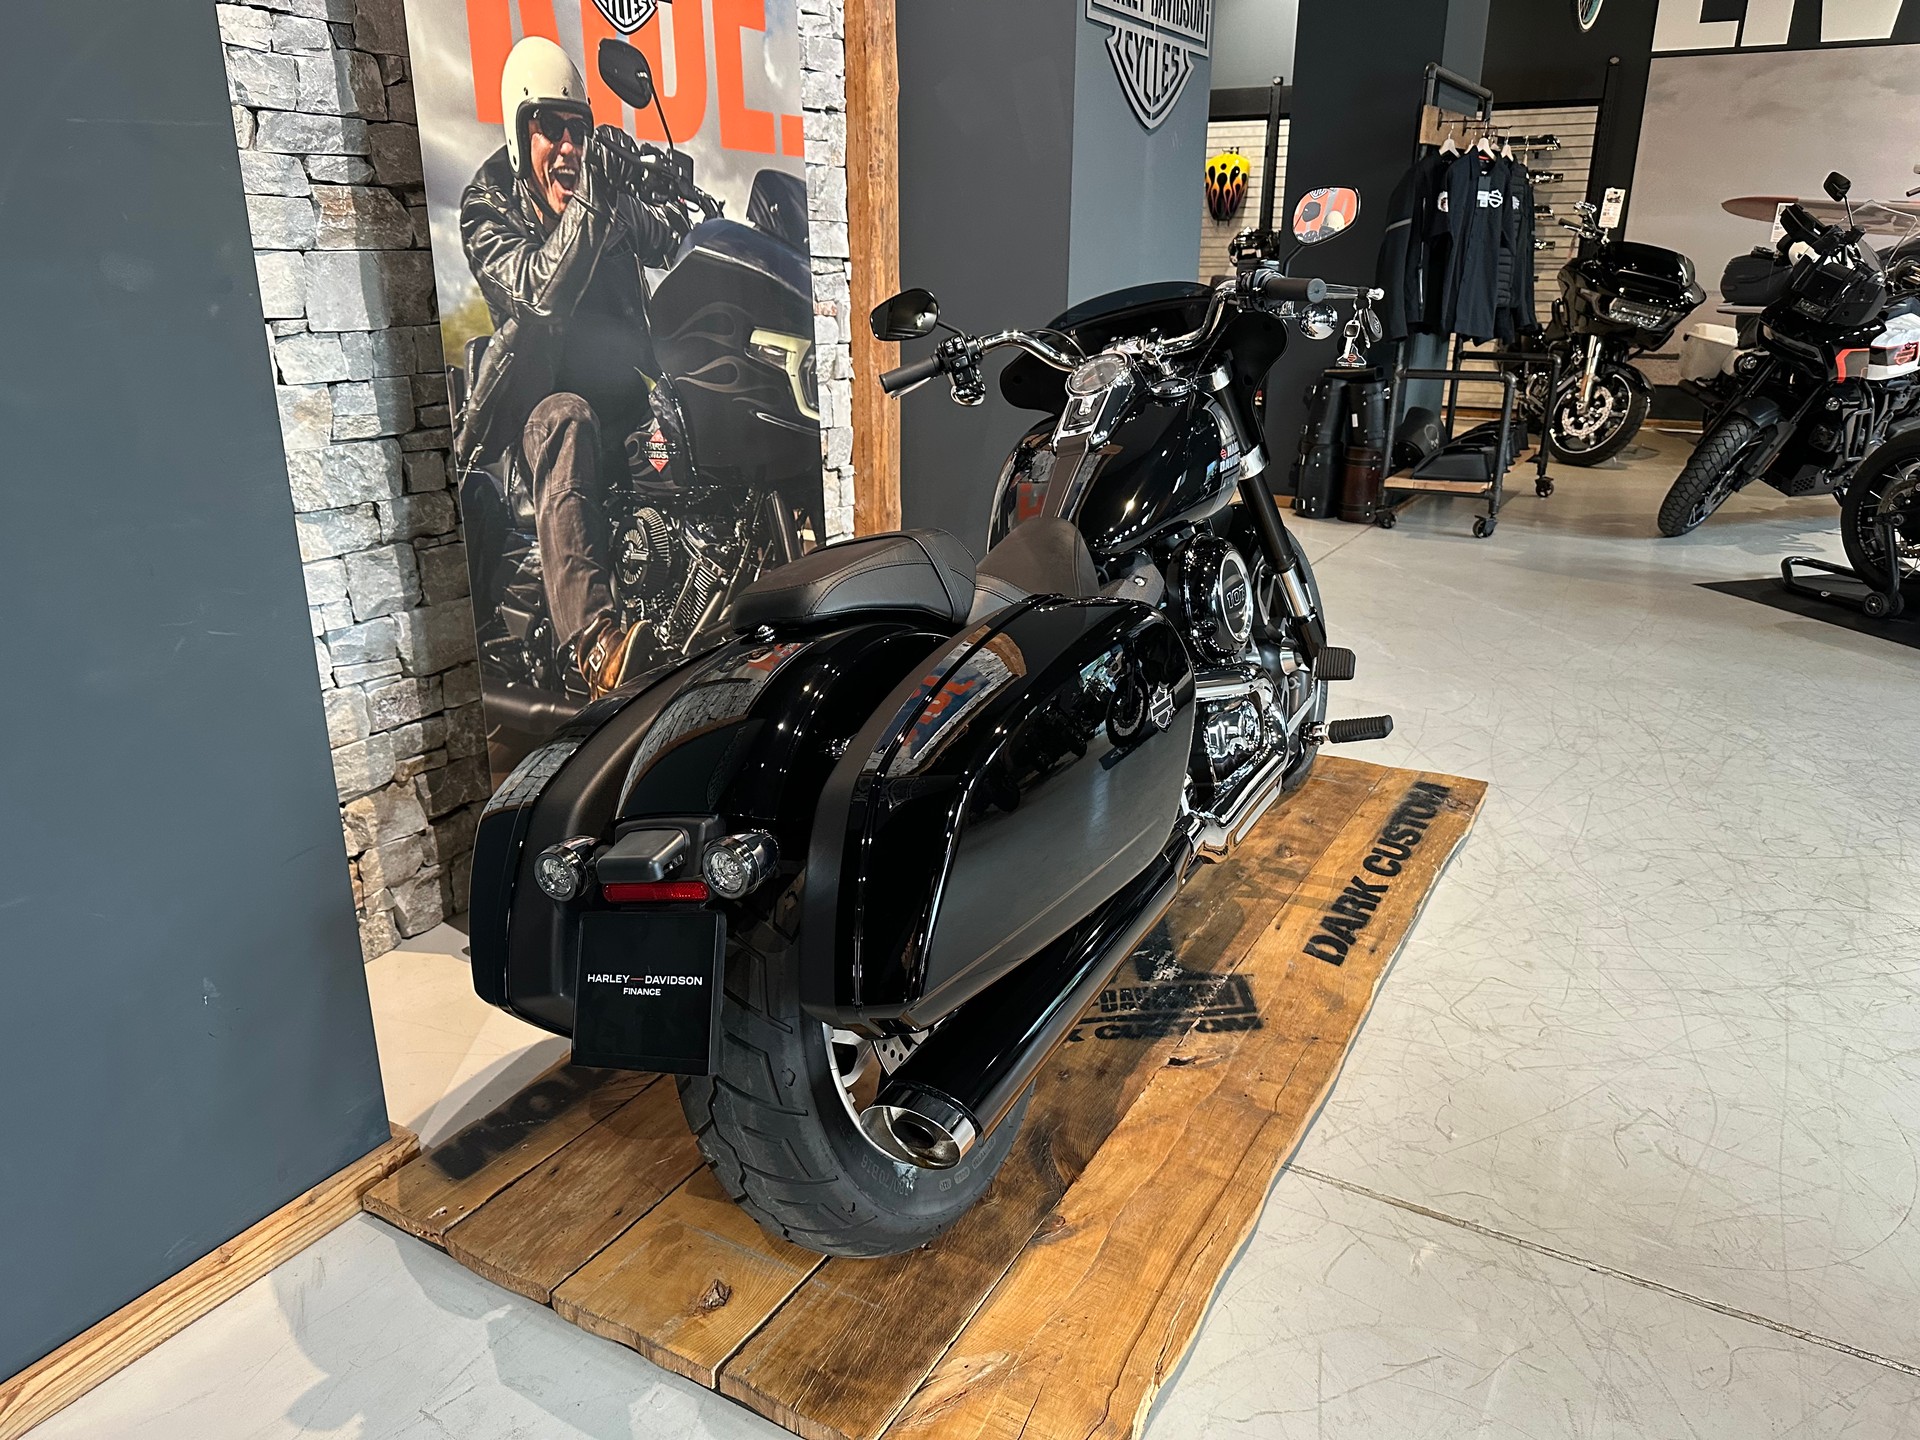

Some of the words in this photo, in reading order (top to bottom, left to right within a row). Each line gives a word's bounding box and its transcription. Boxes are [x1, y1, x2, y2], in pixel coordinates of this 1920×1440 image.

[1124, 29, 1181, 108] CYCLES
[1302, 875, 1390, 967] DARK
[1362, 780, 1451, 878] CUSTOM
[622, 987, 662, 996] FINANCE
